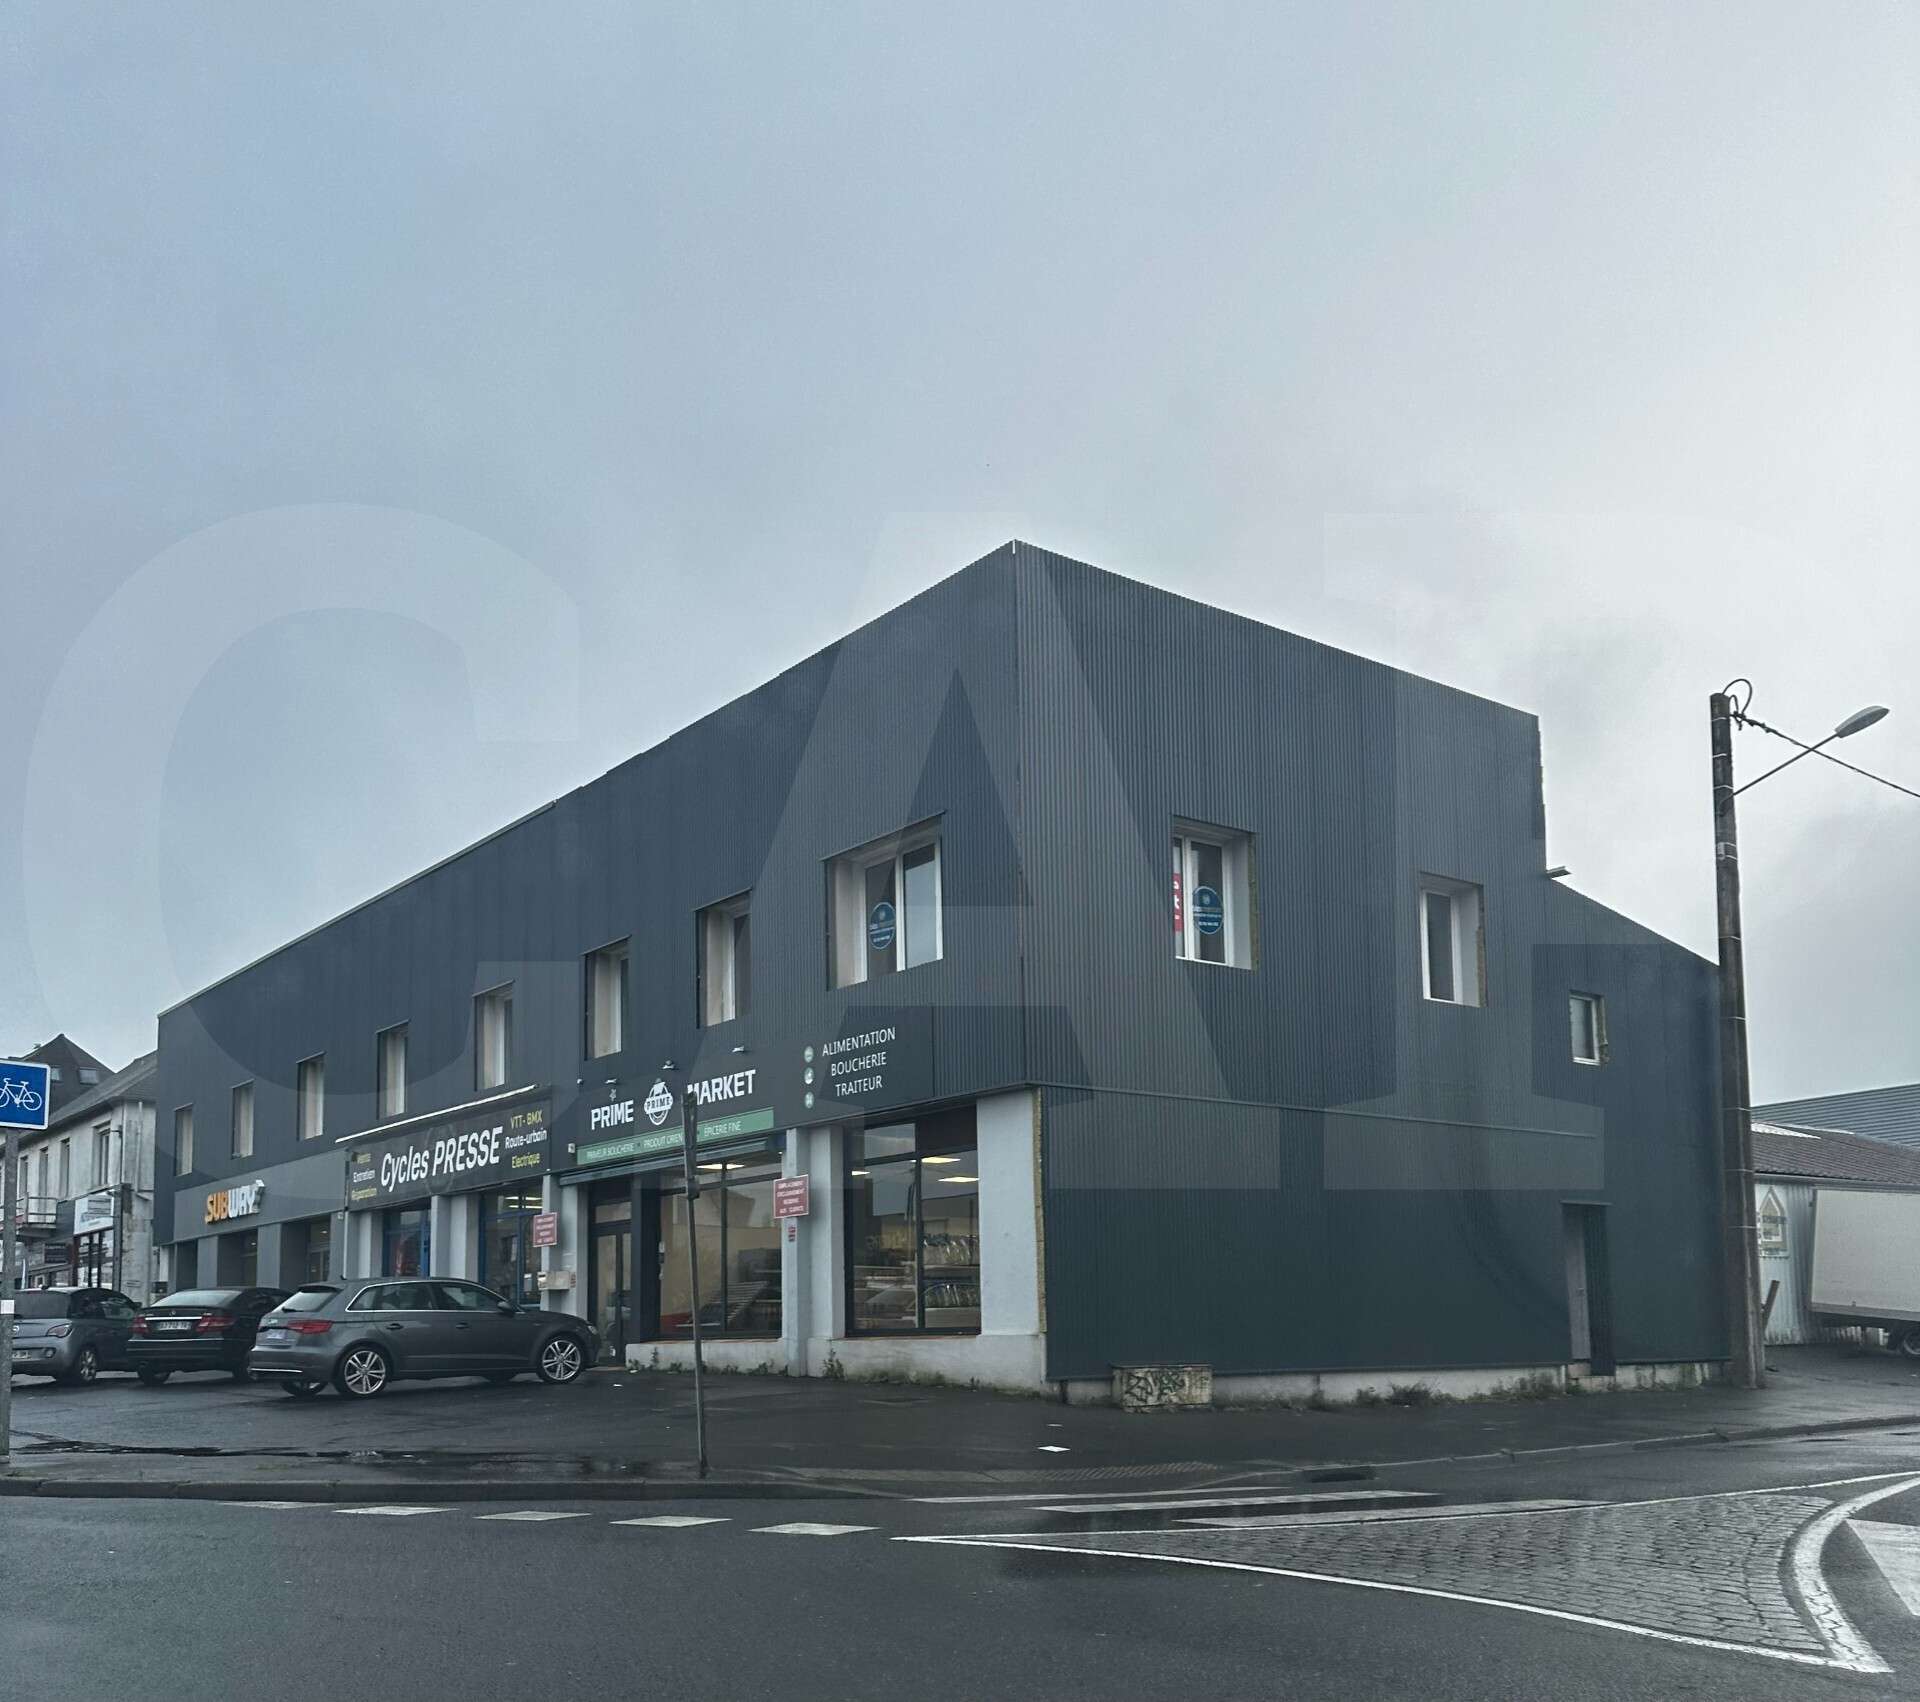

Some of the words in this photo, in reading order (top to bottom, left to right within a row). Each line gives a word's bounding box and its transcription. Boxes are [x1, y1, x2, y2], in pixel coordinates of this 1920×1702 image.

[821, 1026, 896, 1057] ALIMENTATION
[831, 1051, 888, 1077] BOUCHERIE
[834, 1075, 883, 1097] TRAITEUR
[590, 1100, 635, 1131] PRIME
[381, 1146, 430, 1192] Cycles
[432, 1126, 503, 1176] PRESSE
[205, 1179, 265, 1224] SUBWAY
